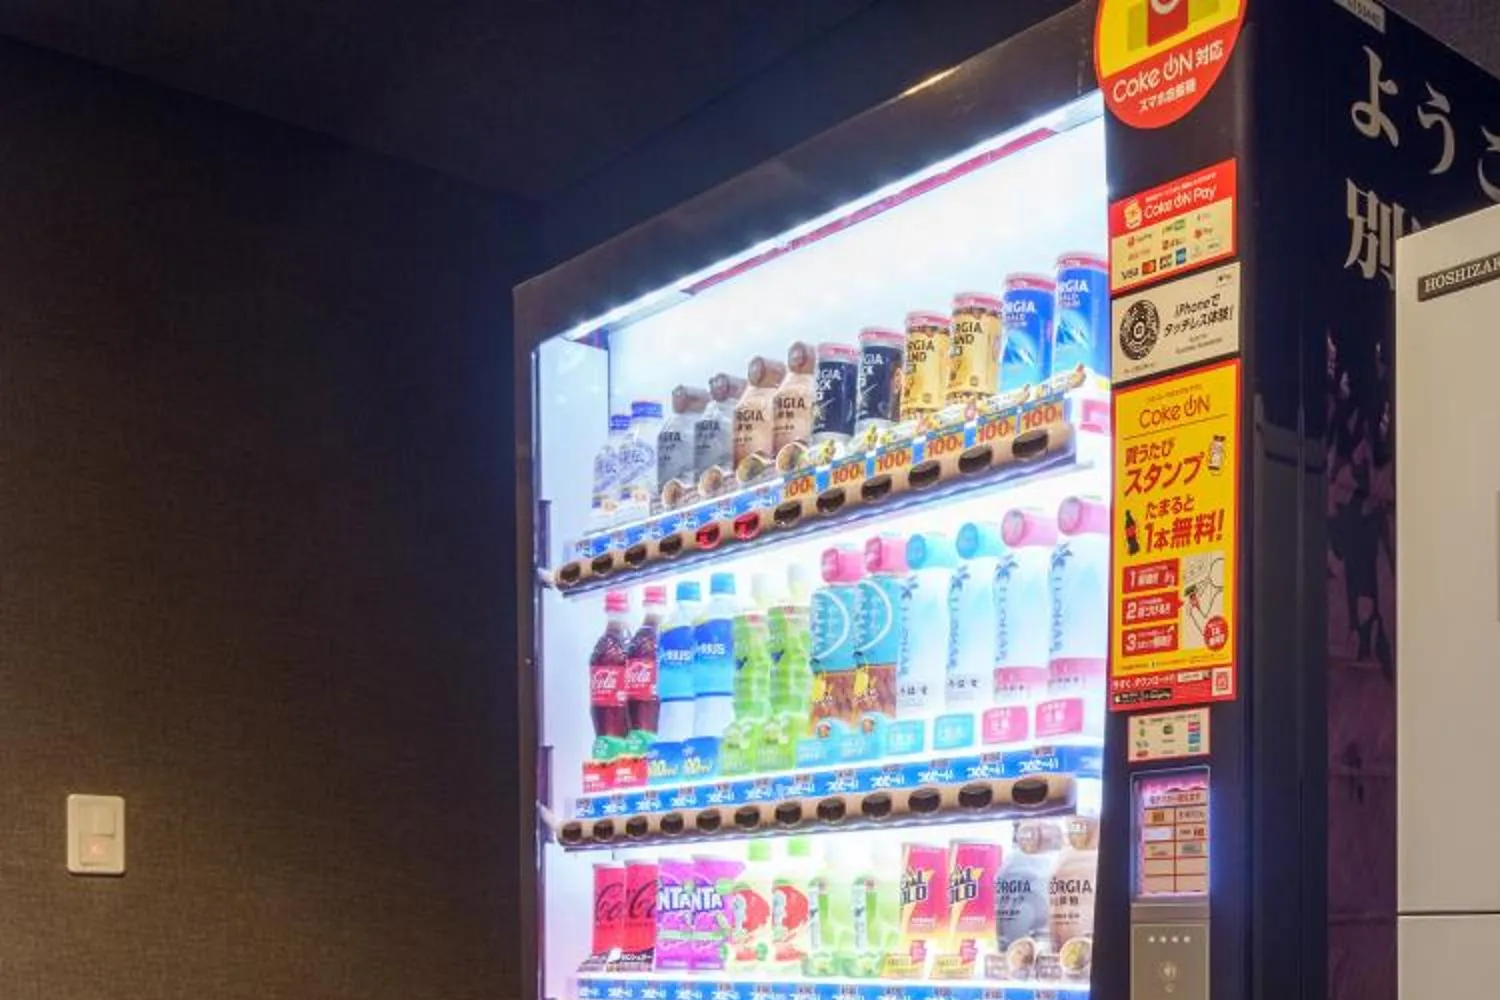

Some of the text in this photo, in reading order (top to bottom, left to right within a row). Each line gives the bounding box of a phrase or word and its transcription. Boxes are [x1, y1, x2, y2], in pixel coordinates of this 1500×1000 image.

[1112, 67, 1160, 102] Coke
[1164, 49, 1193, 80] ON
[1144, 199, 1172, 219] Coke
[1194, 184, 1217, 201] Pay
[1139, 394, 1210, 430] Coke ON
[1124, 451, 1206, 497] スタンプ
[1145, 494, 1195, 520] たまると
